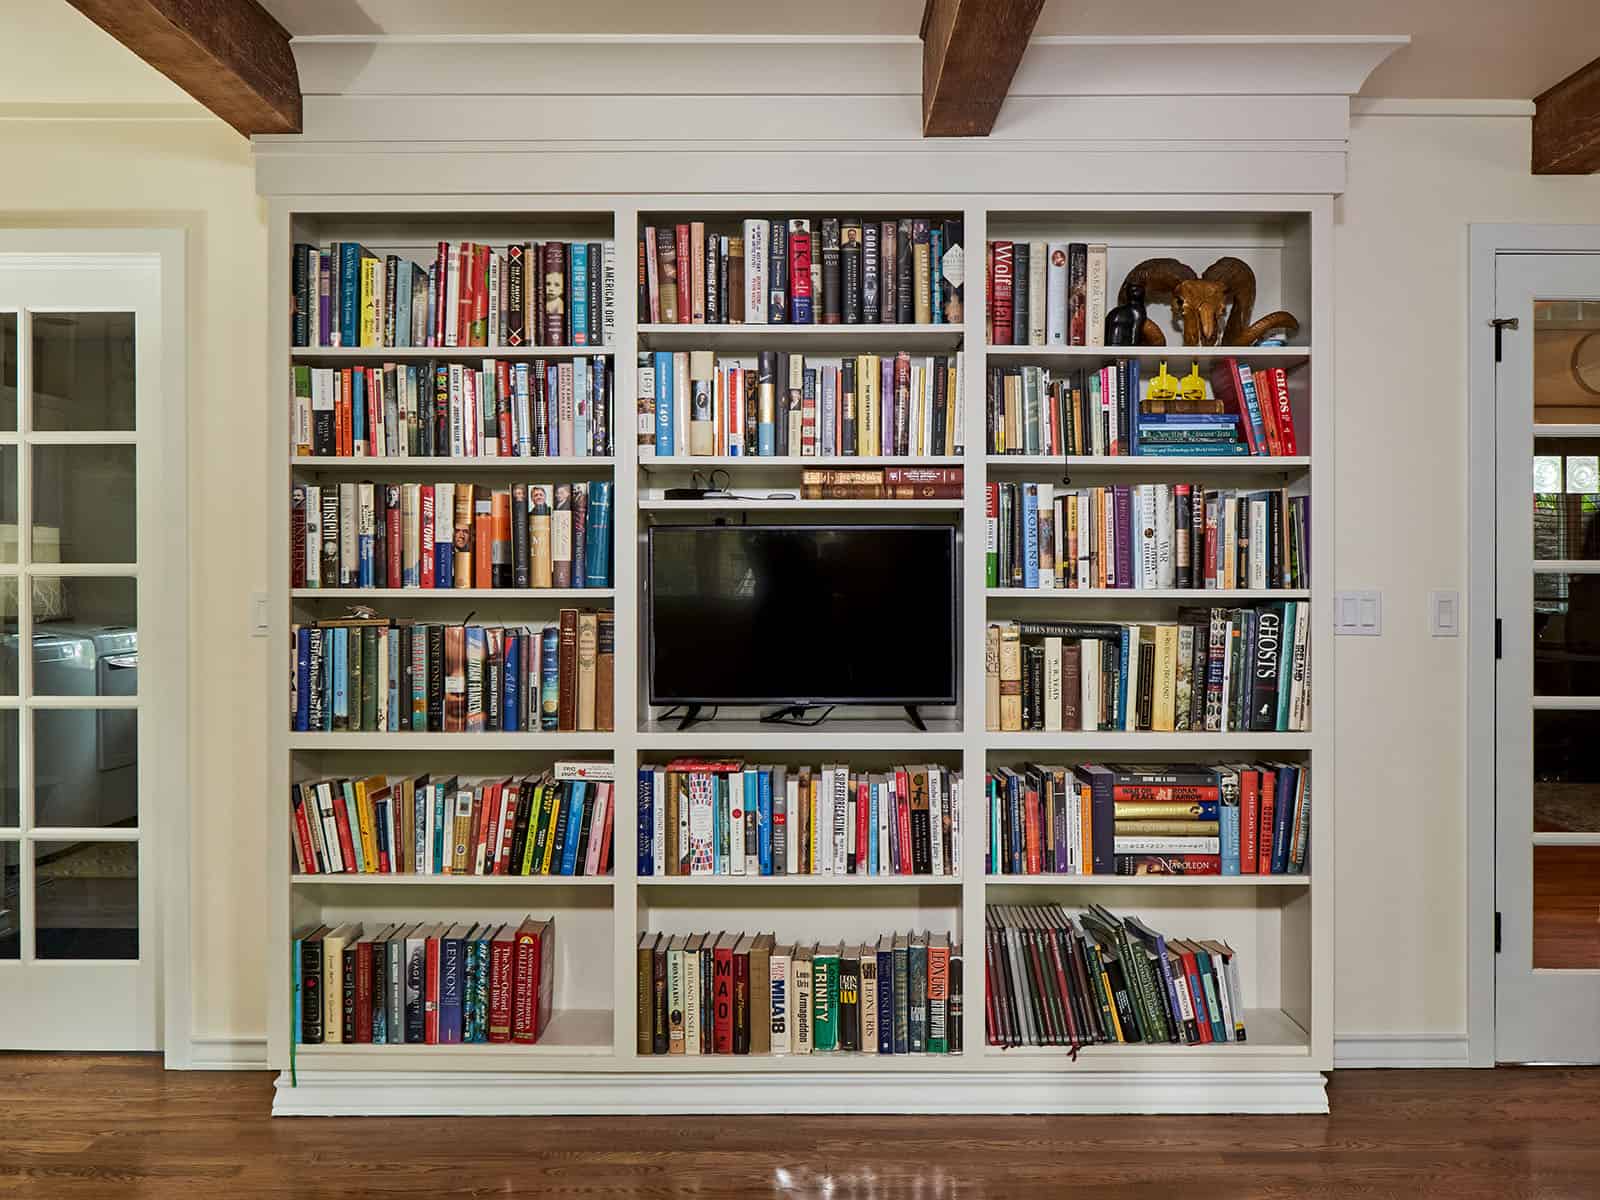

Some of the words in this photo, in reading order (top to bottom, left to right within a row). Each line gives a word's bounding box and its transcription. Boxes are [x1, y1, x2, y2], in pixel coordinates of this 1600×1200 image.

[865, 228, 876, 278] COOLIDGE
[995, 245, 1012, 285] Wolf
[605, 266, 615, 308] AMERICAN
[605, 310, 615, 327] DIRT
[1275, 369, 1289, 413] CHAOS
[660, 403, 669, 427] 1491
[323, 496, 338, 540] Einstein
[424, 496, 433, 516] THIS
[1193, 491, 1201, 529] ZEALOT
[295, 514, 304, 569] EINSTEIN
[424, 524, 433, 550] TOWN
[1028, 508, 1037, 567] ROMANS
[1160, 541, 1168, 562] WAR
[431, 632, 440, 657] JANE
[1256, 613, 1280, 678] GHOSTS
[1294, 644, 1305, 682] IRELAND
[431, 659, 440, 697] FONDA
[1162, 670, 1171, 698] IRELAND
[468, 683, 481, 713] FRANZEN
[834, 773, 848, 837] SUPERFORECASTING
[1248, 831, 1253, 839] IN
[1158, 856, 1210, 870] NAPOLEON
[412, 951, 420, 980] SAVAGE
[445, 941, 457, 996] LENNON
[493, 947, 501, 986] Annotated
[518, 945, 528, 982] COLLEGE
[671, 963, 679, 990] BONANZA
[828, 962, 838, 984] Leon
[930, 951, 946, 975] LEON
[412, 985, 420, 1014] BEAUTY
[492, 989, 500, 1010] Bible
[500, 981, 508, 1010] Oxford
[686, 963, 694, 1002] BERTRAND
[716, 960, 730, 1018] MAO
[772, 980, 785, 1017] MILA
[815, 963, 828, 1022] TRINITY
[865, 981, 874, 1012] LEON
[344, 990, 353, 1031] POWER
[516, 984, 527, 1032] DICTIONARY
[687, 1004, 695, 1039] RUSSELL
[772, 1017, 785, 1034] 18
[797, 992, 809, 1043] Armageddon
[866, 1014, 875, 1036] URIS
[931, 1000, 944, 1038] REDEMPTION
